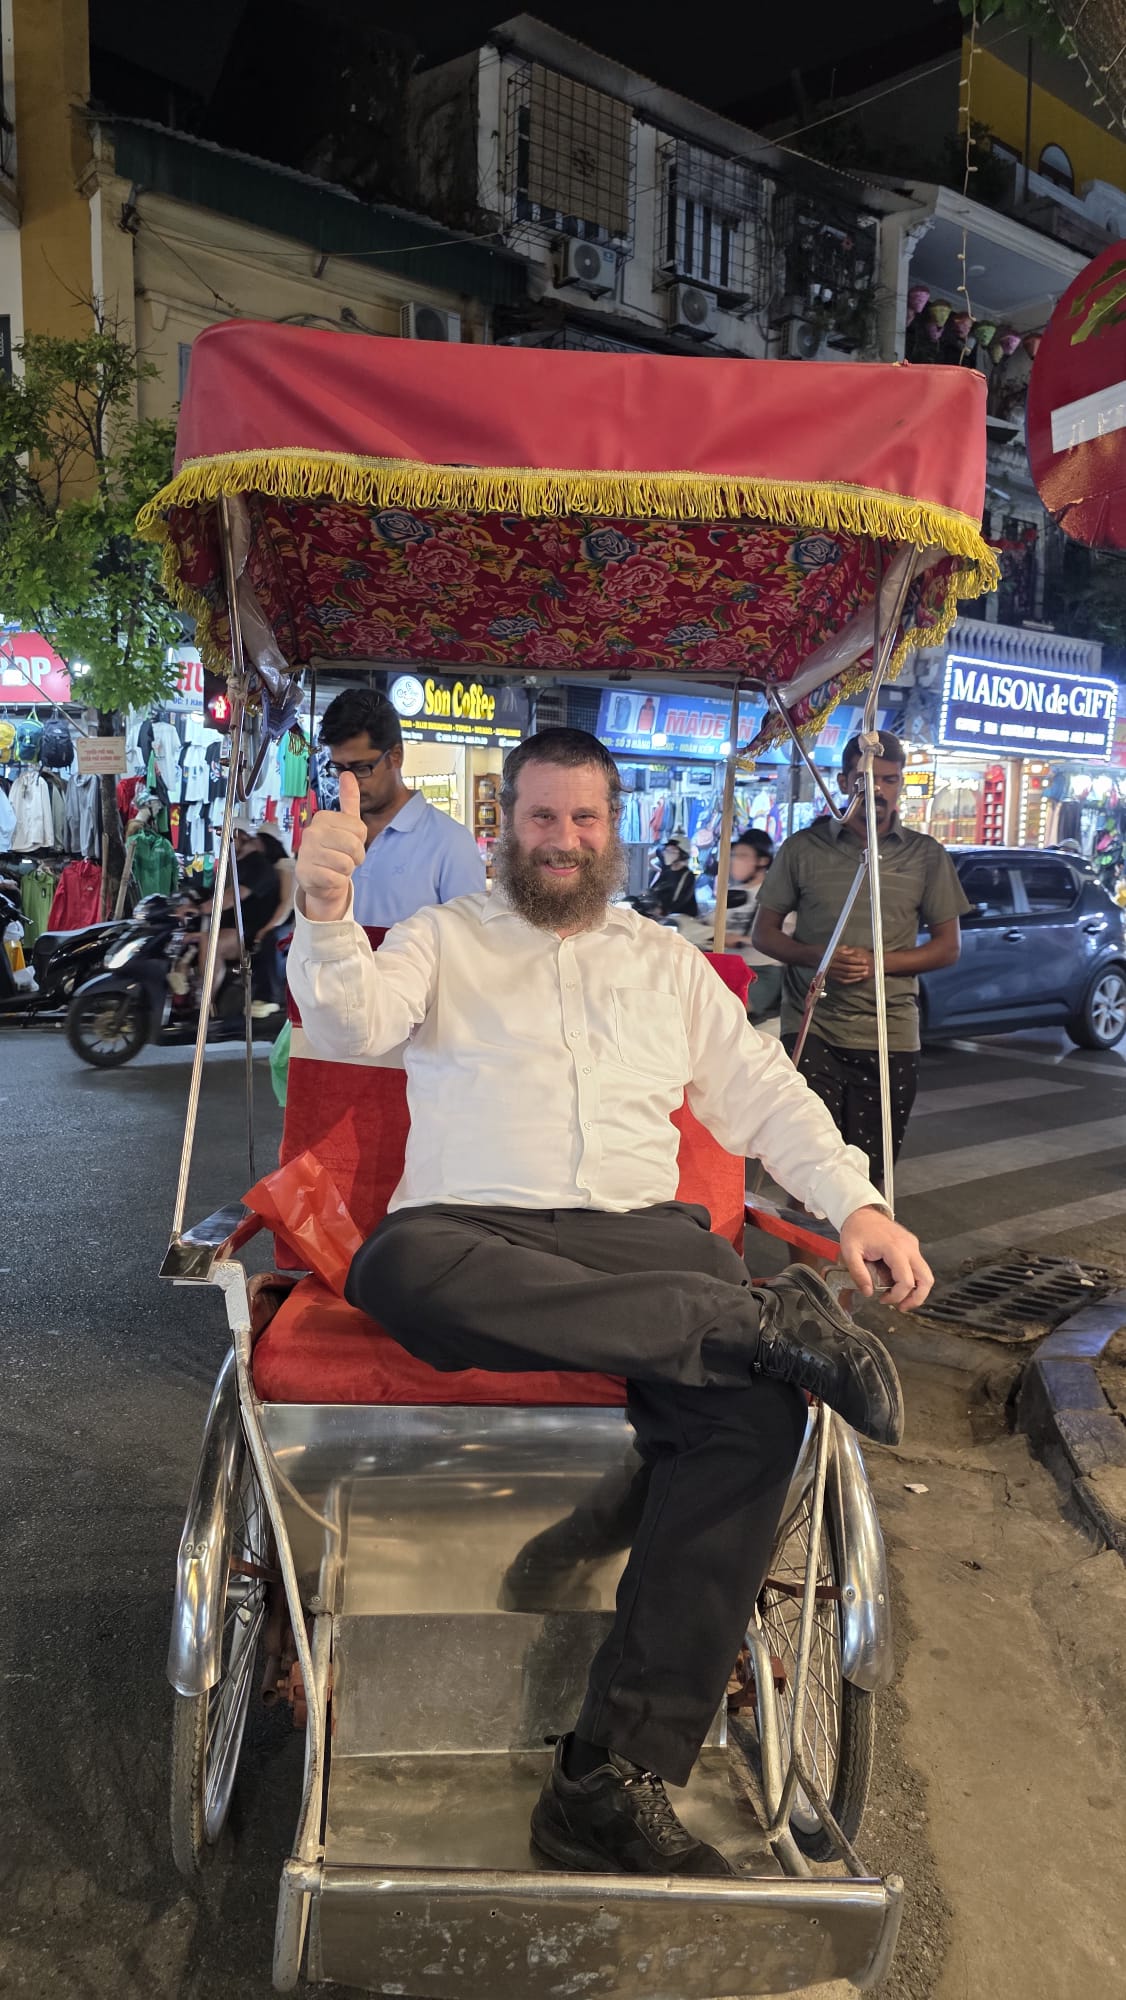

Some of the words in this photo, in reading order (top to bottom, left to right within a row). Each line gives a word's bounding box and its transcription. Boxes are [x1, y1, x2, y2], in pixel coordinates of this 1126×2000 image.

[453, 681, 495, 720] Coffee
[951, 668, 1046, 712] MAISON
[1045, 684, 1069, 714] de
[1069, 686, 1113, 719] GIFT
[664, 708, 729, 739] MADE
